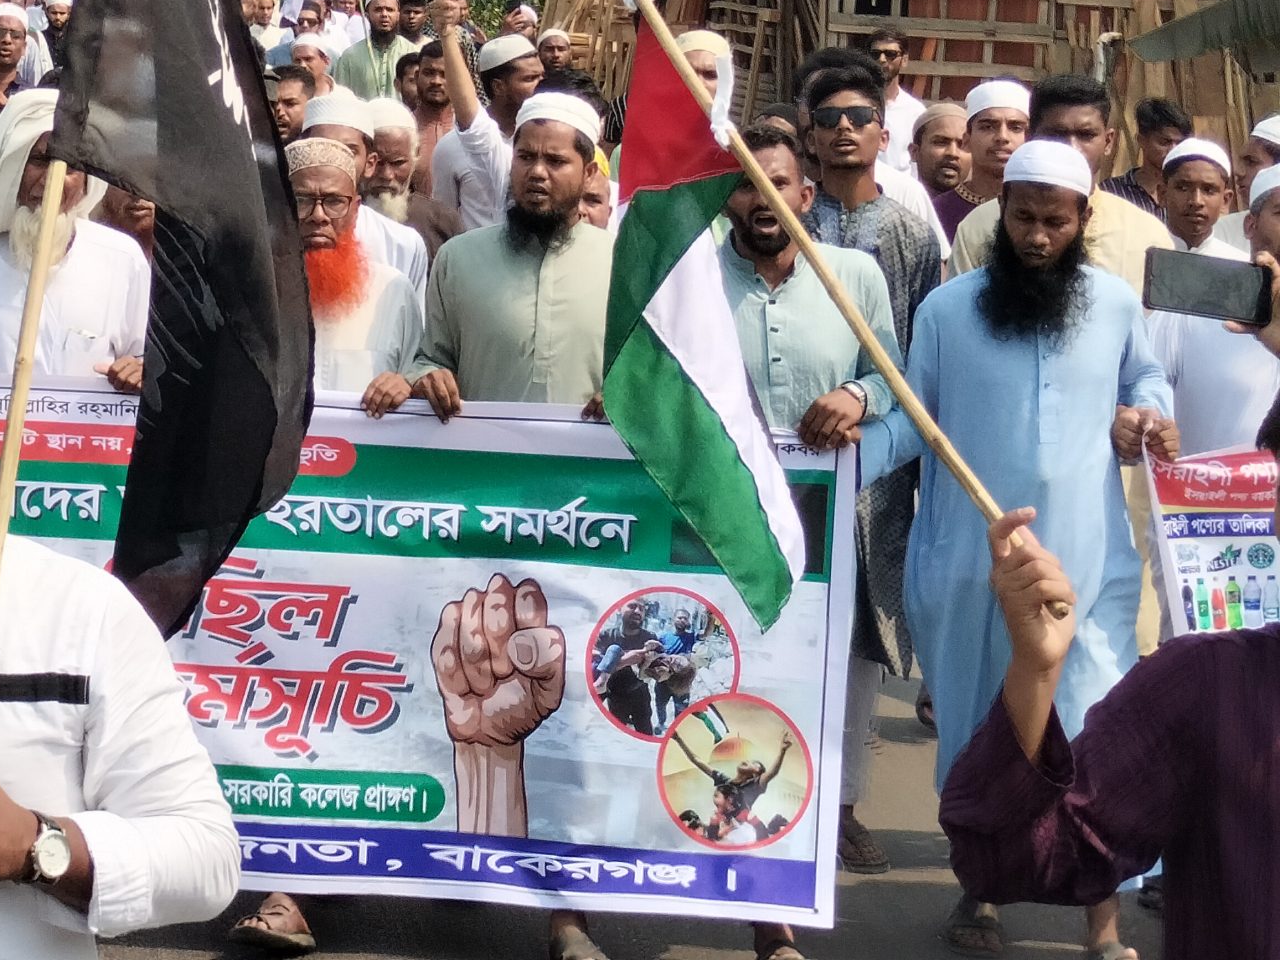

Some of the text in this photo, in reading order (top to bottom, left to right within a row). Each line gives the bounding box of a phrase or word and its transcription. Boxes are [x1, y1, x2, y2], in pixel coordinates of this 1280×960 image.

[266, 495, 639, 553] হরতালের সমর্থনে
[1228, 514, 1271, 534] তালিকা
[172, 641, 412, 760] র্মসূচি
[222, 773, 294, 808] সরকারি
[298, 783, 361, 810] কলেজ
[364, 783, 418, 812] প্রাঙ্গণ
[422, 843, 697, 888] বাকেরগঞ্জ
